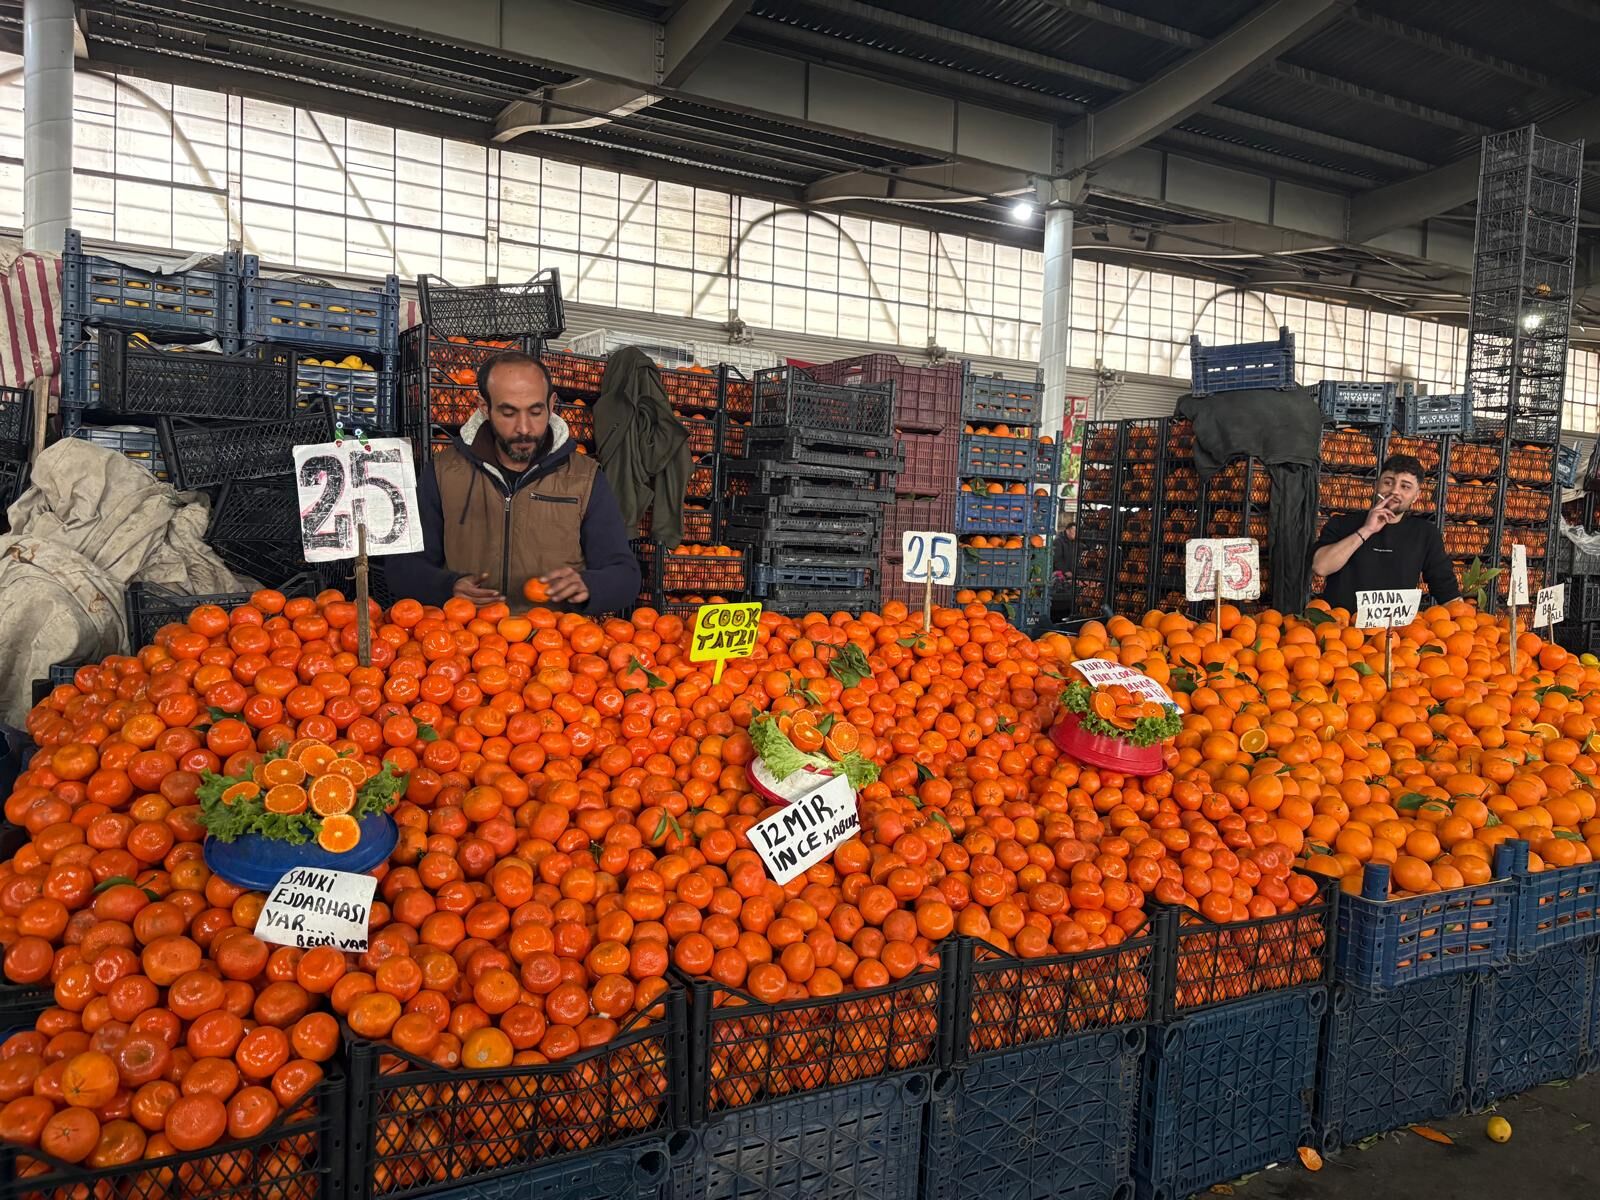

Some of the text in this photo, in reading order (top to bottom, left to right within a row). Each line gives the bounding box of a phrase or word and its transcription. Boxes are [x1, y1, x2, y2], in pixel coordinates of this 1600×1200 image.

[300, 448, 408, 550] 25
[906, 535, 952, 580] 25
[1194, 543, 1253, 593] 25
[1361, 591, 1404, 606] ADANA
[1538, 590, 1554, 605] BAL
[1542, 602, 1557, 616] BAL
[768, 812, 860, 872] İNCE KABUK
[280, 870, 338, 893] SANKİ
[296, 931, 368, 950] BELKİ VAR
